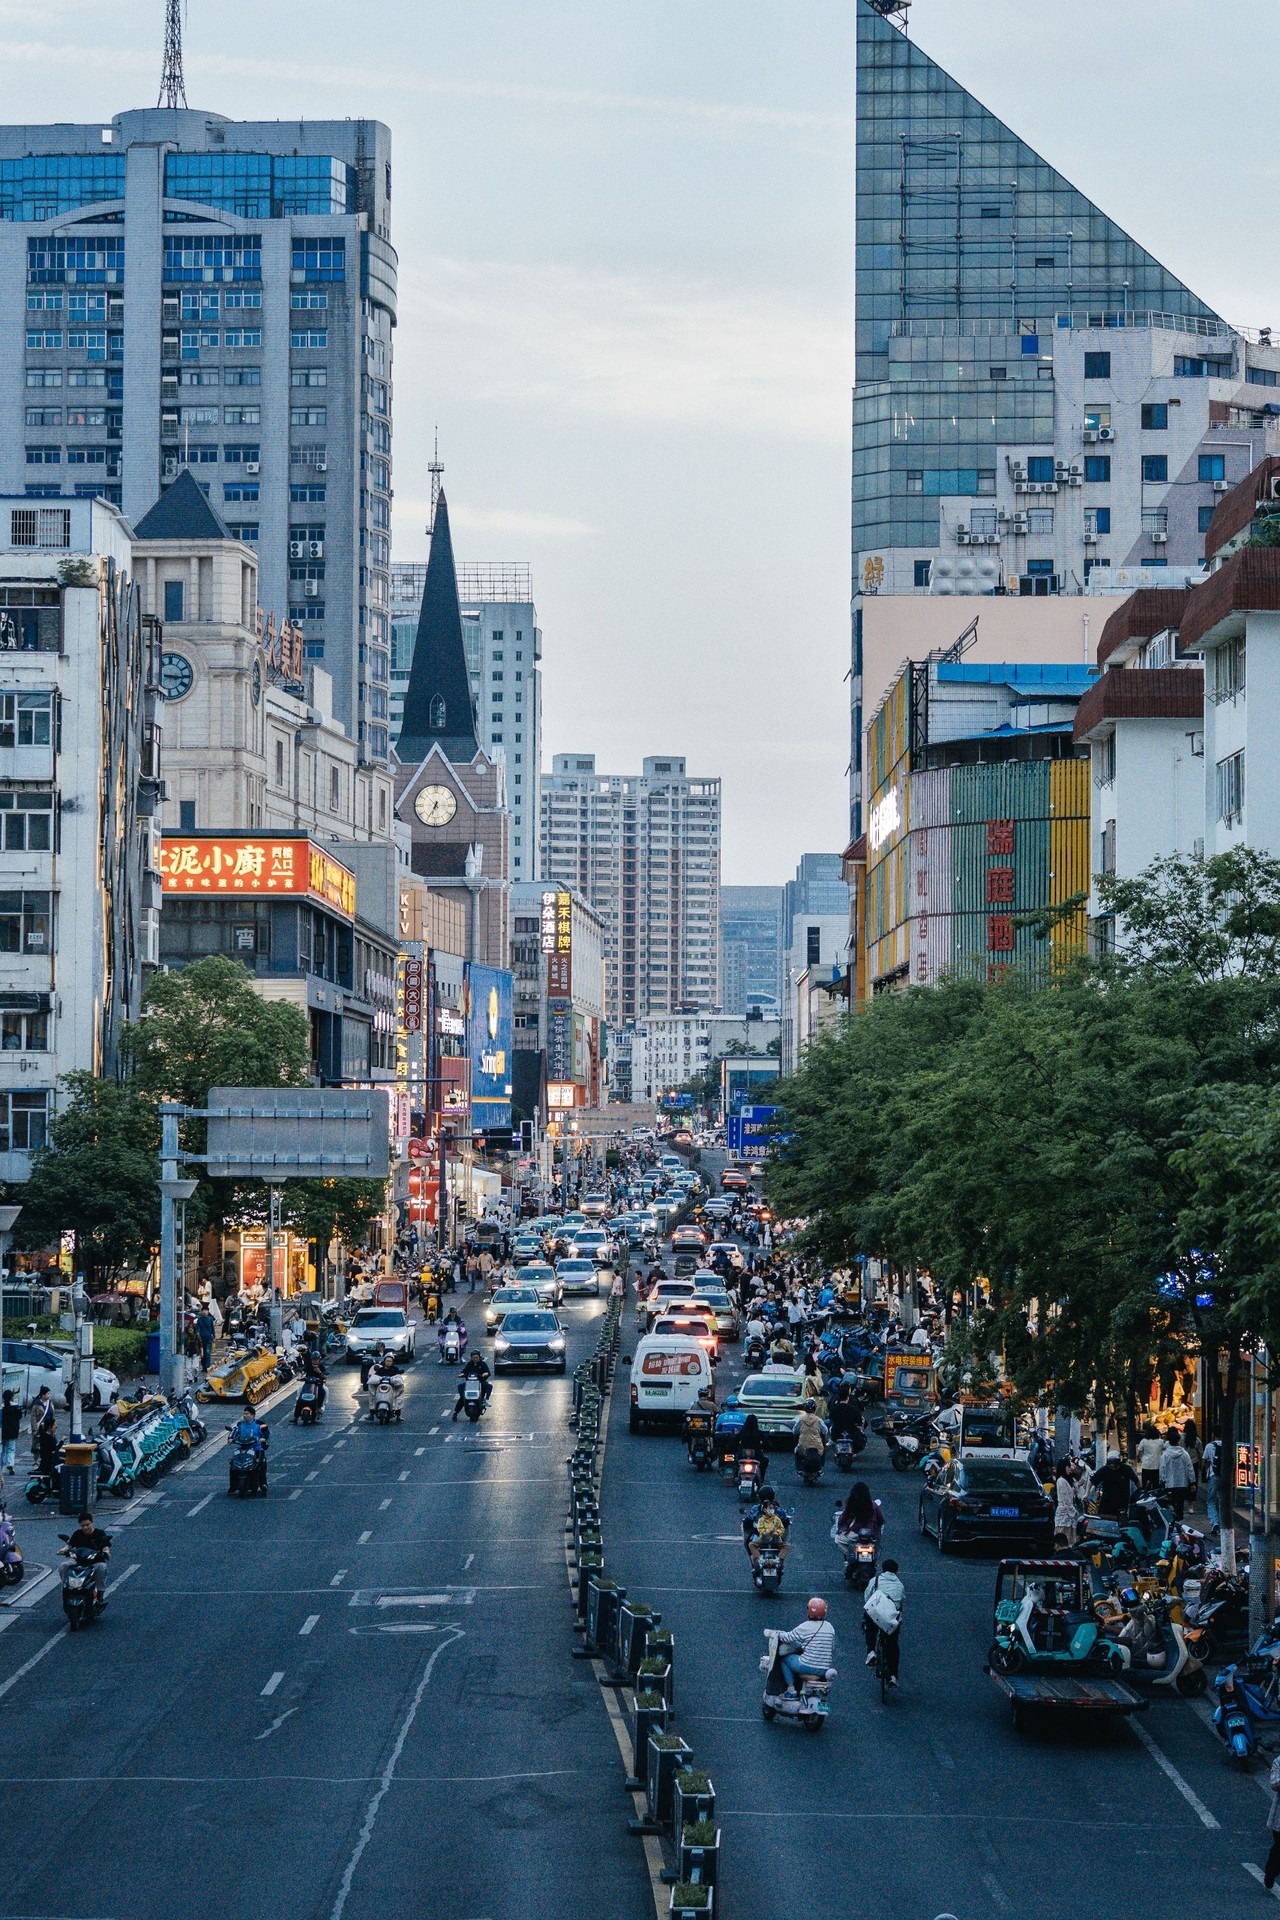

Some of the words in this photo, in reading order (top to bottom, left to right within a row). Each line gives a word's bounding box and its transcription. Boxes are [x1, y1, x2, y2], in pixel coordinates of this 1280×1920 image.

[272, 859, 293, 869] 入口
[400, 895, 409, 934] KTV
[542, 892, 555, 948] 伊朵酒店
[557, 892, 571, 948] 嘉禾棋牌
[236, 928, 254, 950] 宵
[888, 1355, 930, 1366] 水电安装维修
